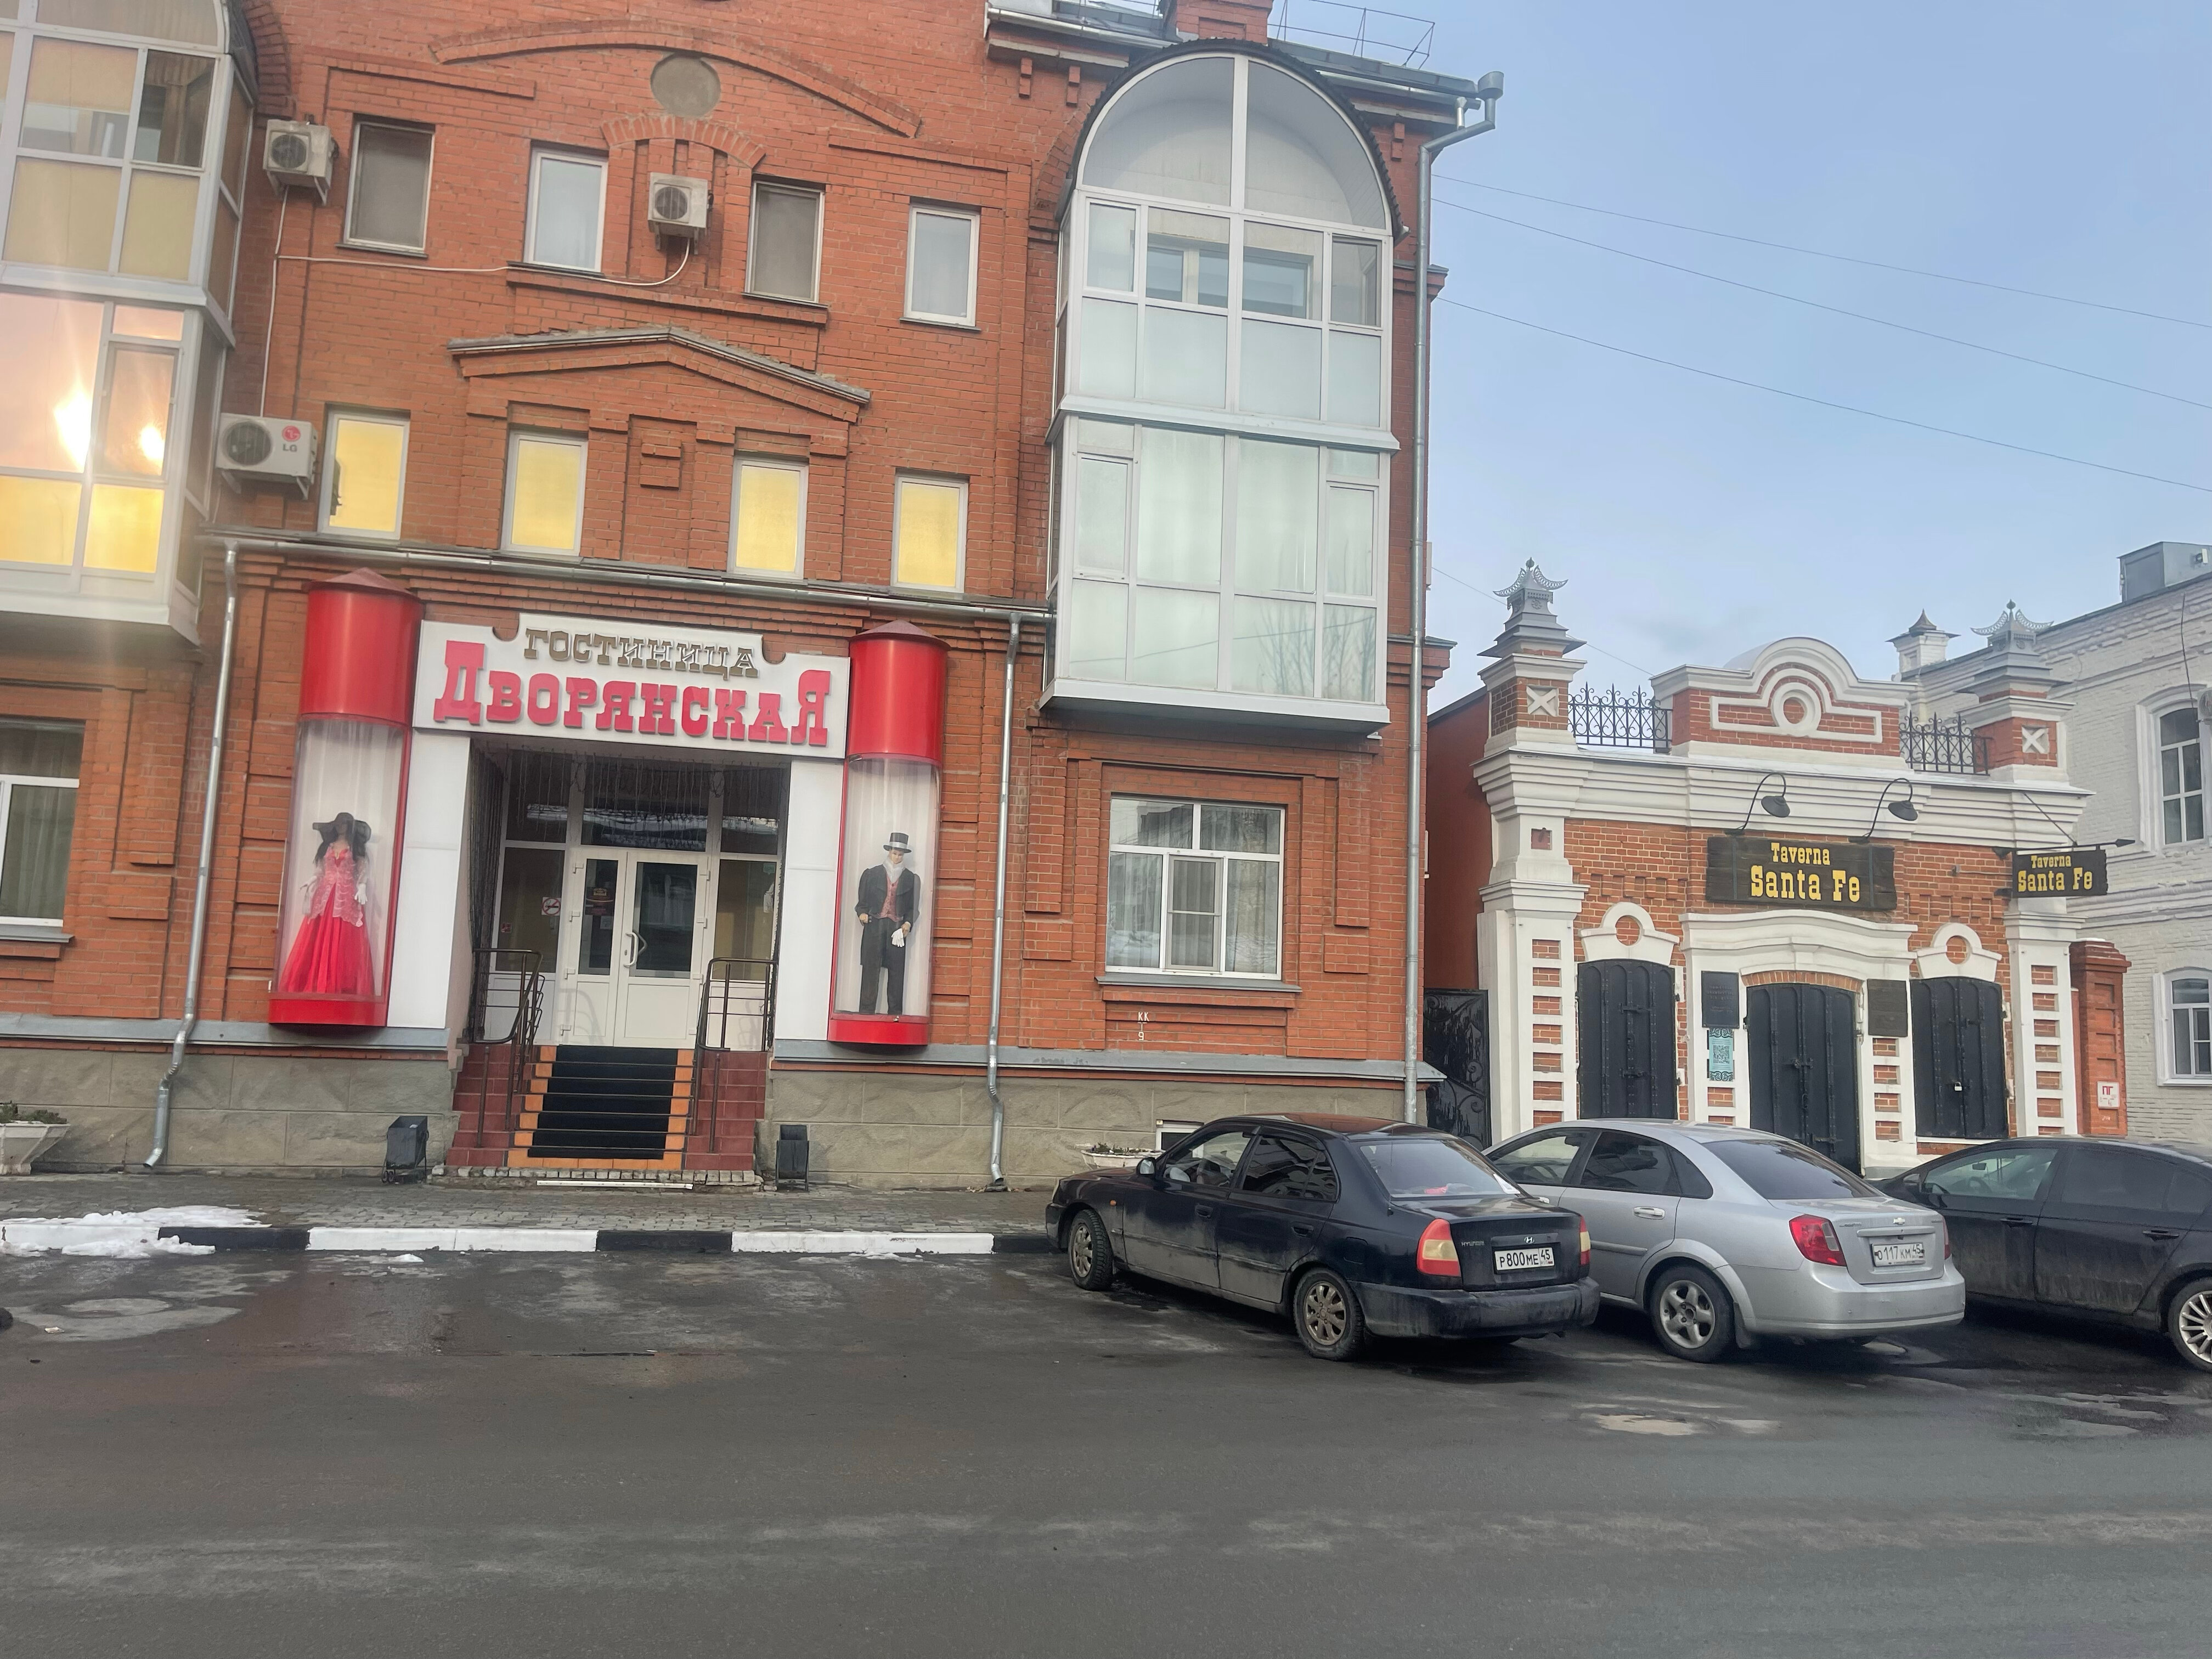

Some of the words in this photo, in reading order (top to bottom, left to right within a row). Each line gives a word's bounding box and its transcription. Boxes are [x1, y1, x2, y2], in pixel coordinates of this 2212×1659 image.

[283, 443, 298, 453] LG
[523, 628, 759, 680] ГОСТИНИЦА
[433, 640, 832, 746] ДВОРЯНСКАЯ
[1771, 842, 1831, 865] Taverna
[2031, 855, 2072, 868] Taverna
[1751, 865, 1821, 900] Santa
[1832, 870, 1860, 902] Fe
[2018, 870, 2065, 892] Santa
[2073, 867, 2092, 890] Fe
